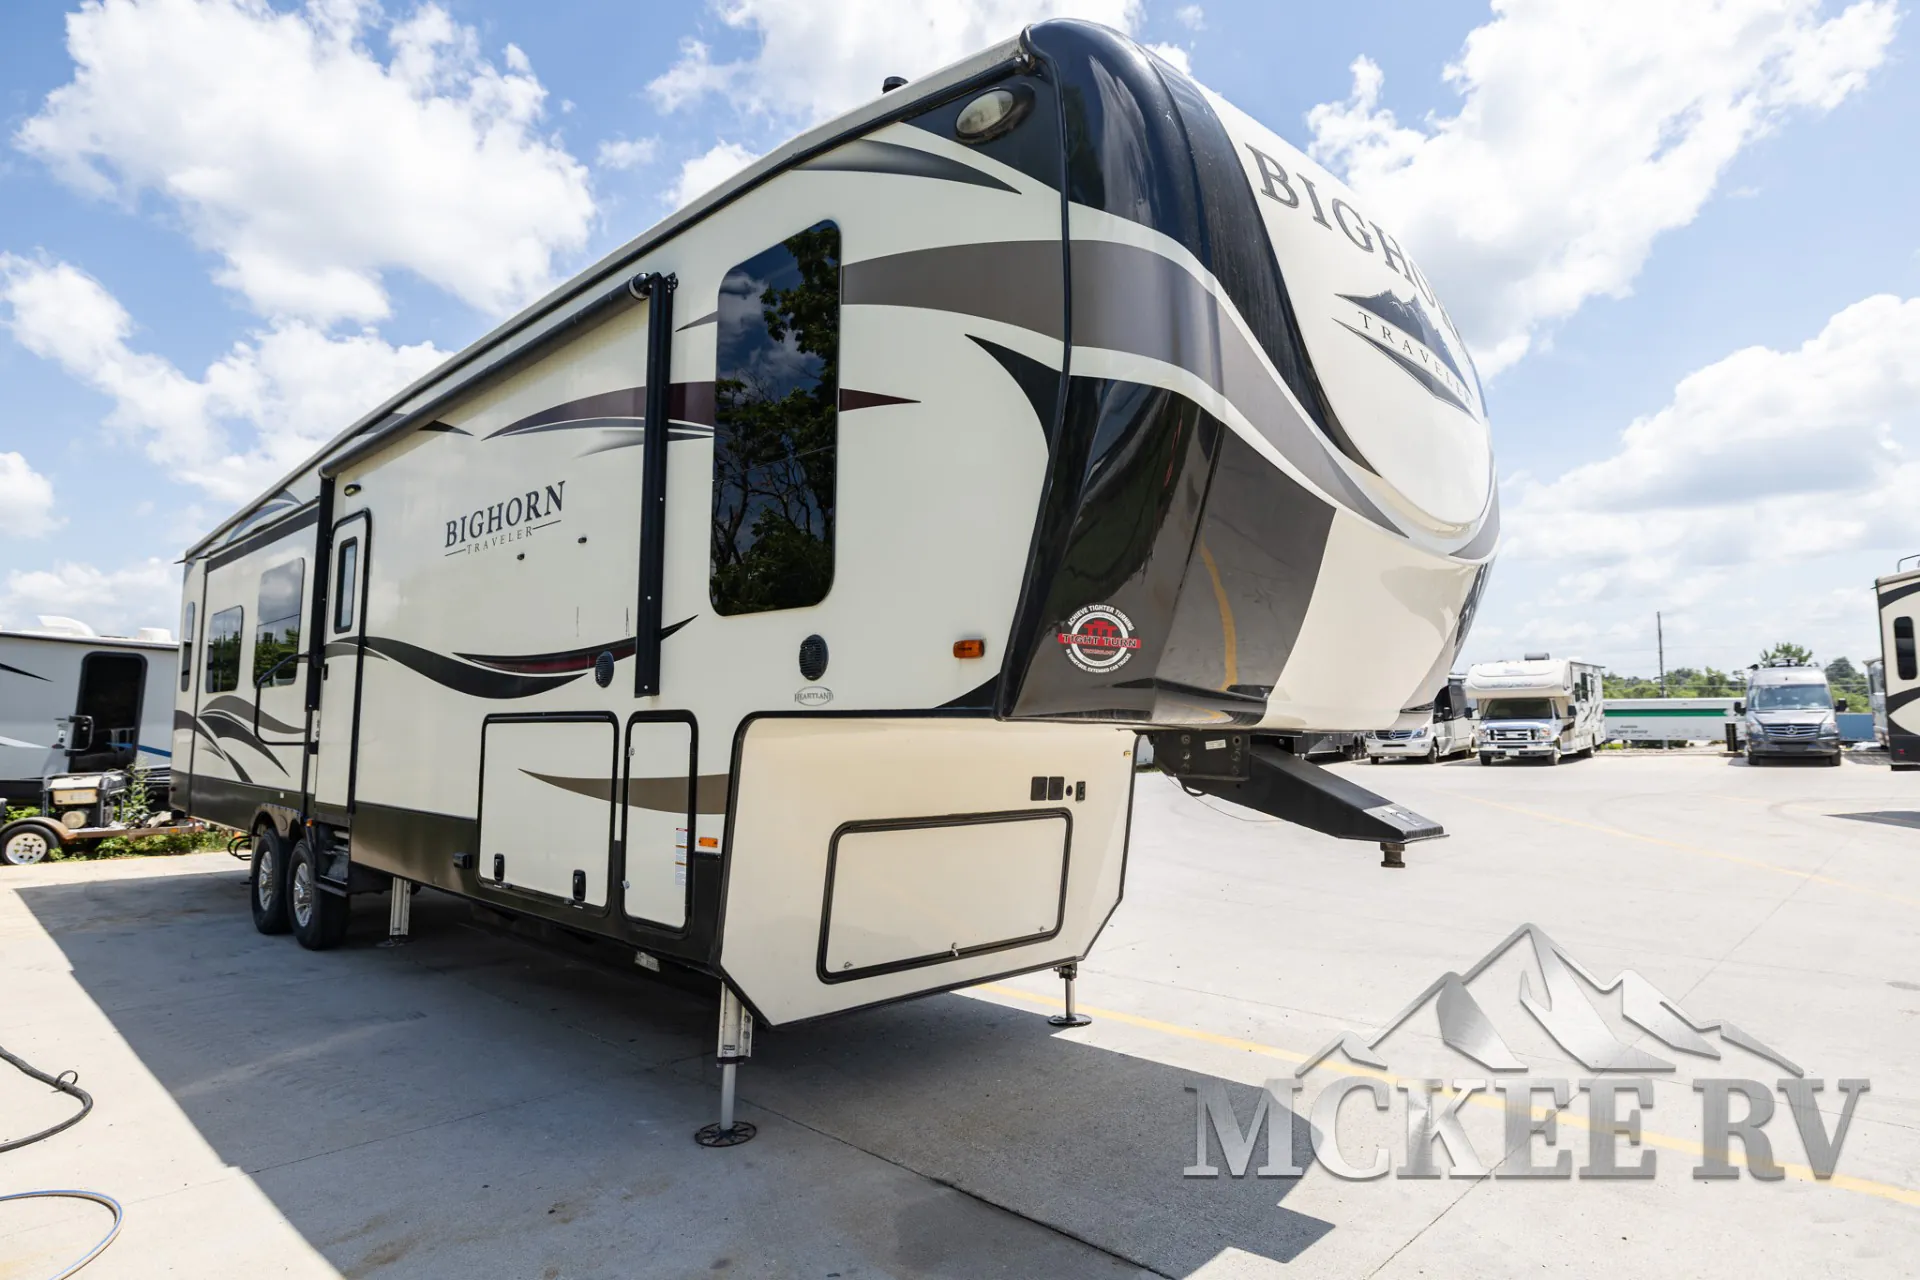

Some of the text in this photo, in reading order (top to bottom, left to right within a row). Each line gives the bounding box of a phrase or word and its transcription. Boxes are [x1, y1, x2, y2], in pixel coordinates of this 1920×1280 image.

[445, 480, 565, 548] BIGHORN
[466, 526, 533, 554] TRAVELER
[1067, 607, 1088, 626] ACHIEVE
[1088, 604, 1114, 613] TIGHTER
[1114, 609, 1135, 631] TURNING
[1063, 635, 1137, 648] TIGHT TURN
[794, 692, 834, 702] HEARTLAND
